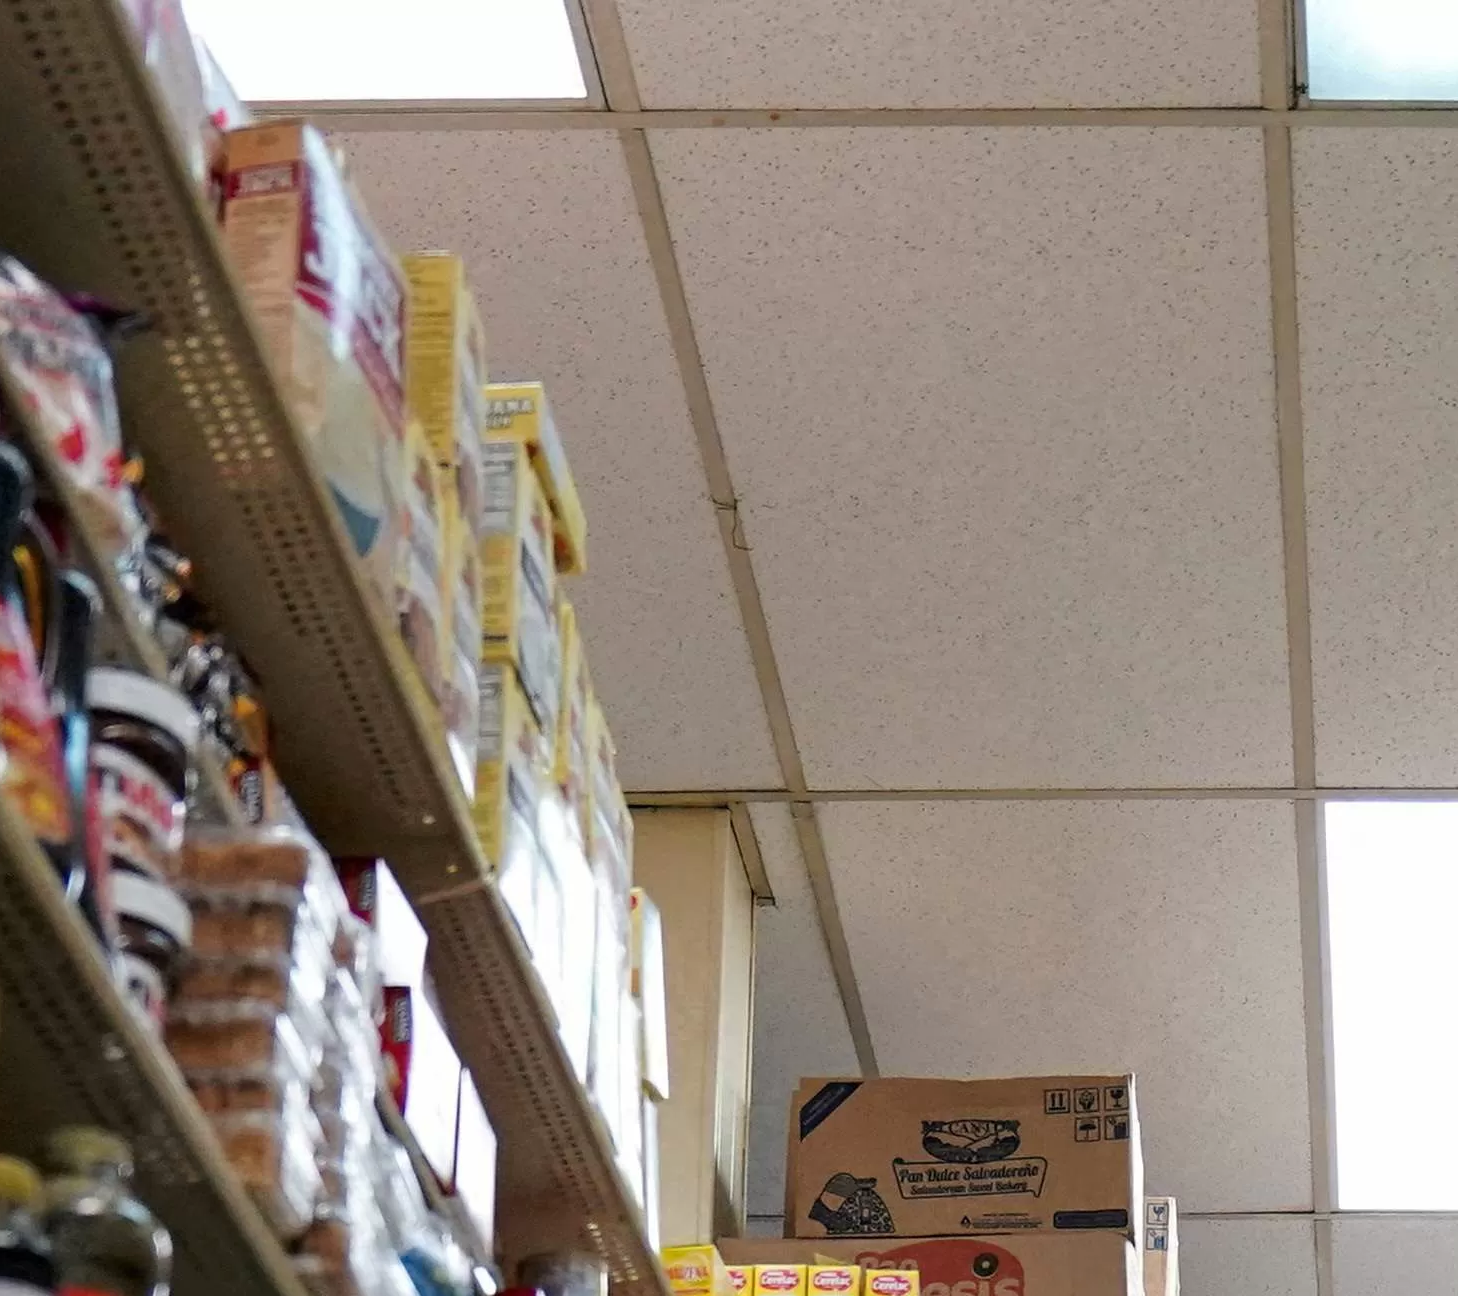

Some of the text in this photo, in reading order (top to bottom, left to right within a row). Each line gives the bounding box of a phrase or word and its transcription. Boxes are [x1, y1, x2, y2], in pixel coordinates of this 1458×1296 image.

[899, 1164, 1039, 1183] Pan Dulce Salvadoreño
[873, 1279, 910, 1292] Cerelac
